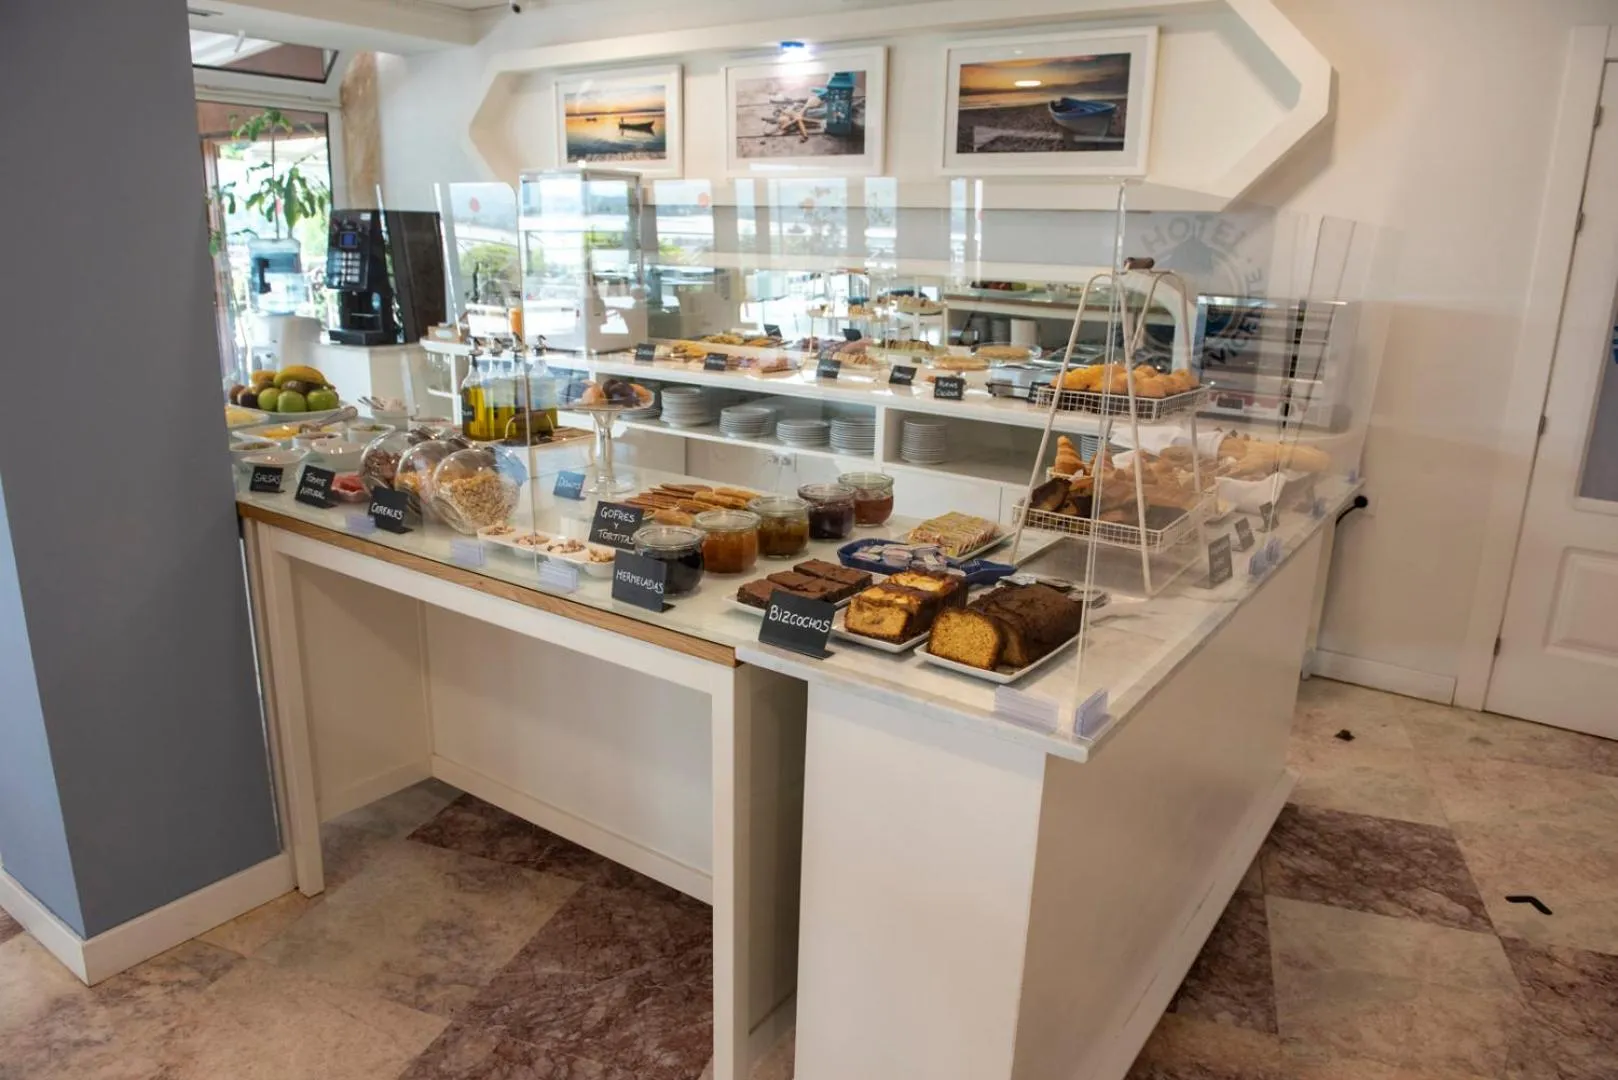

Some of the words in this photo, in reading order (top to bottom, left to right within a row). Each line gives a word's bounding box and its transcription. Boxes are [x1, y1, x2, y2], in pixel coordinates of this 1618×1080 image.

[1140, 214, 1246, 255] HOTEL
[371, 502, 403, 520] CEREALES
[600, 506, 635, 523] GOFRES
[614, 522, 619, 530] Y
[597, 528, 635, 545] TORTITAS
[768, 604, 832, 634] BIZCOCHOS
